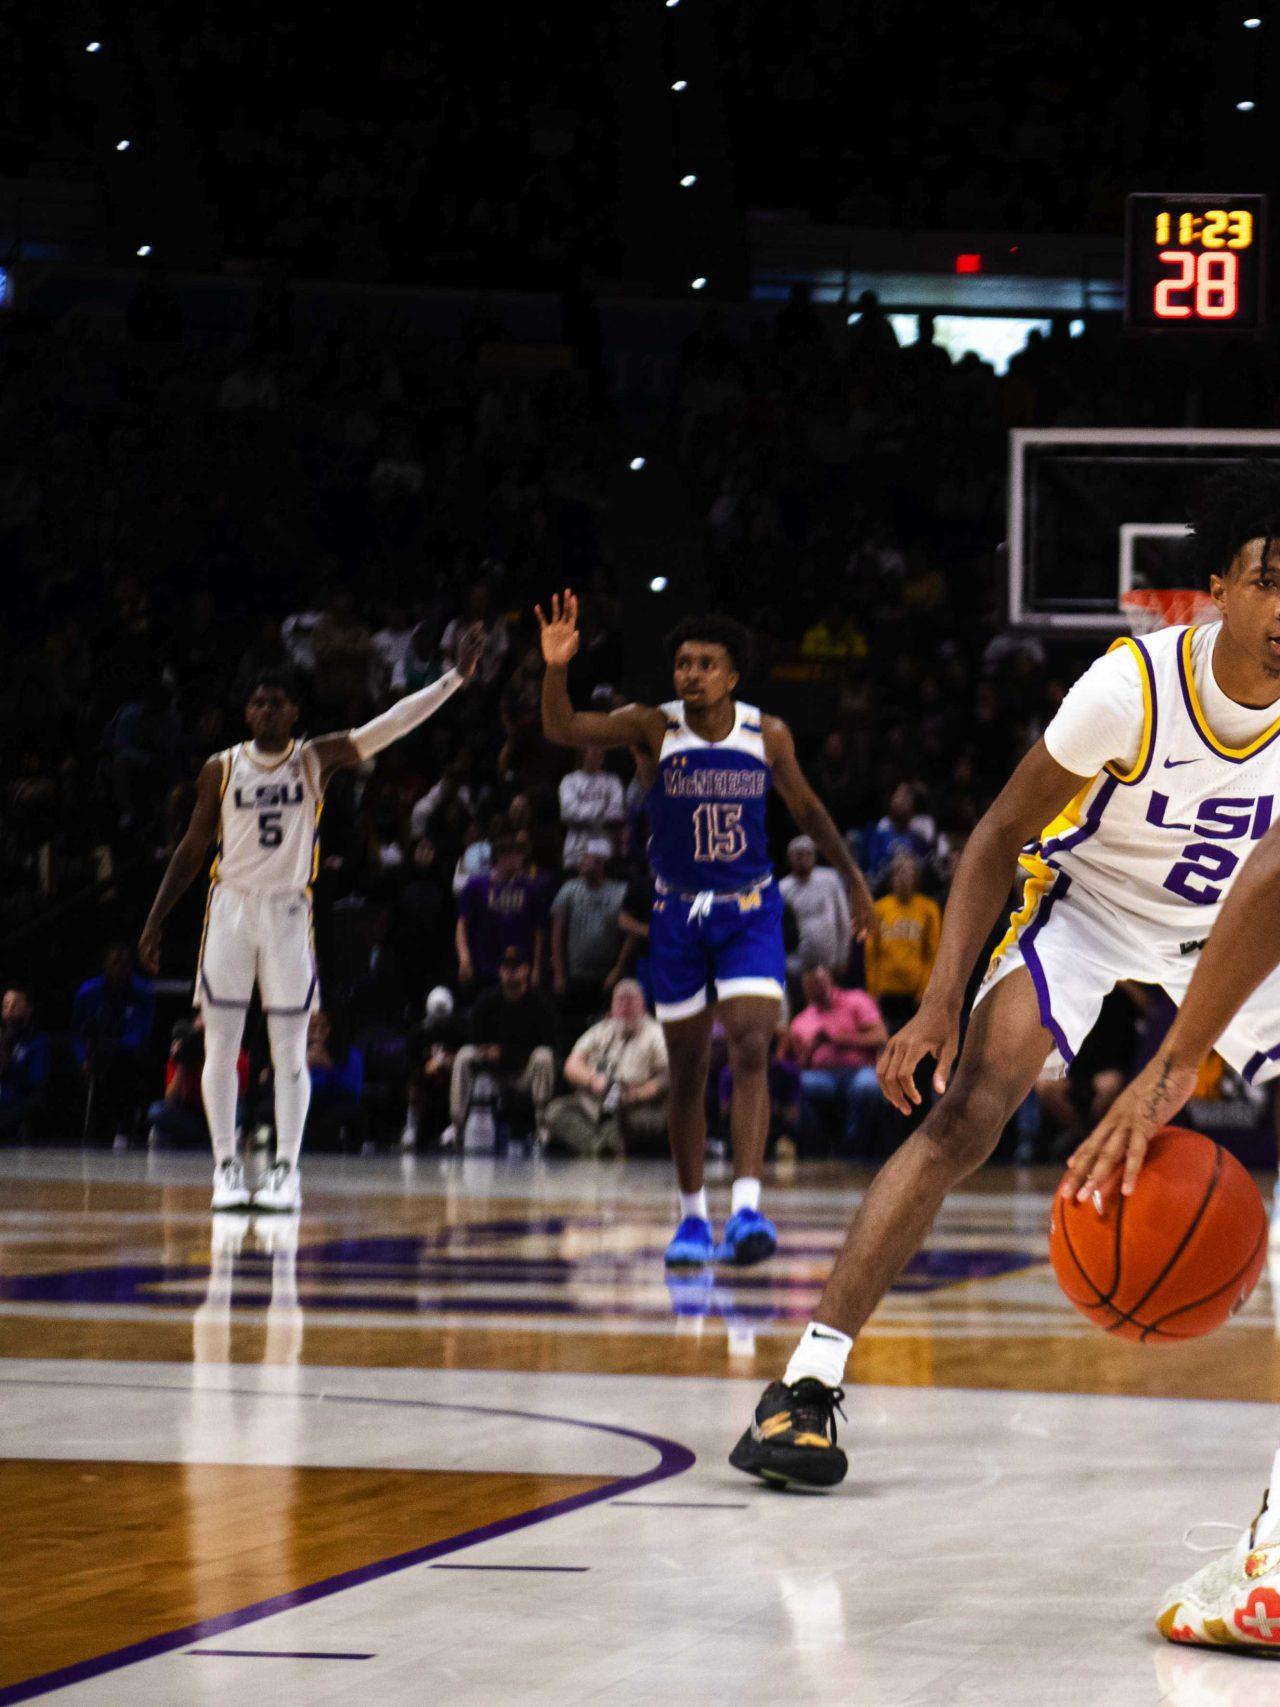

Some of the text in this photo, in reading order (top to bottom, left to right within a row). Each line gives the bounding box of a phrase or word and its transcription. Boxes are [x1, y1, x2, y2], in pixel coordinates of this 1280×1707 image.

[1156, 210, 1253, 249] 11:23
[1154, 251, 1238, 319] 28
[235, 782, 303, 811] LSU
[259, 811, 283, 848] 5
[693, 802, 747, 862] 15
[1163, 842, 1239, 905] 2
